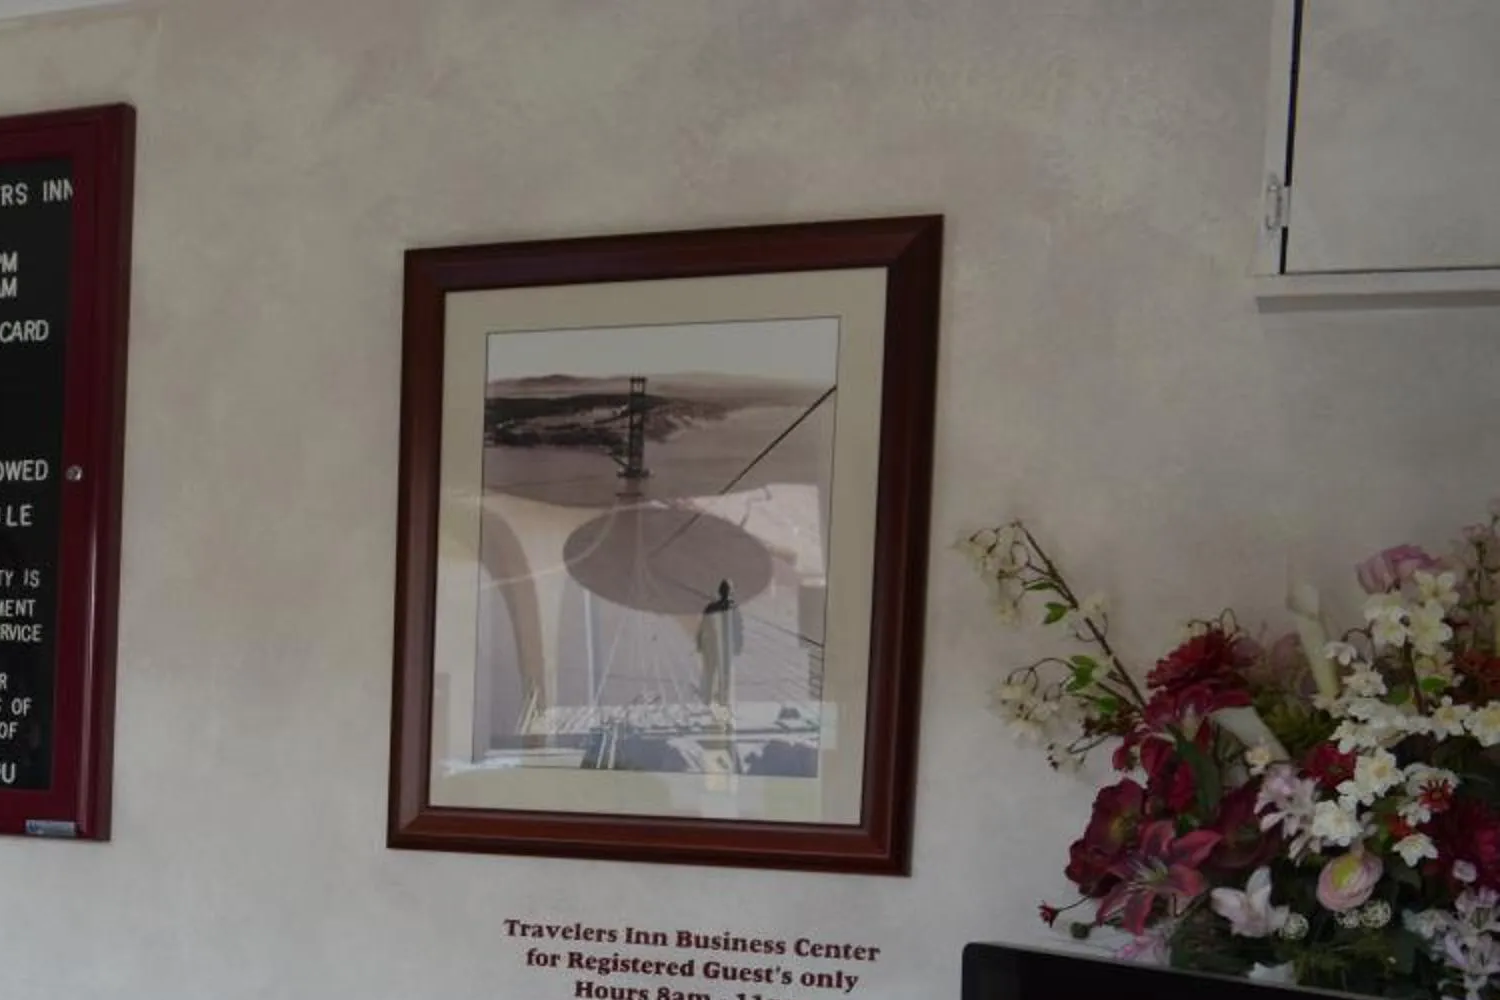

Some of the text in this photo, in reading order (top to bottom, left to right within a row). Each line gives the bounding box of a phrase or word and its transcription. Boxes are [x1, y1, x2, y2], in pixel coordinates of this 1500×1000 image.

[0, 319, 49, 342] CARD
[23, 569, 40, 588] IS
[12, 698, 32, 716] OF
[504, 919, 881, 962] Travelers Inn Business Center
[527, 948, 859, 993] for Registered Guest's only
